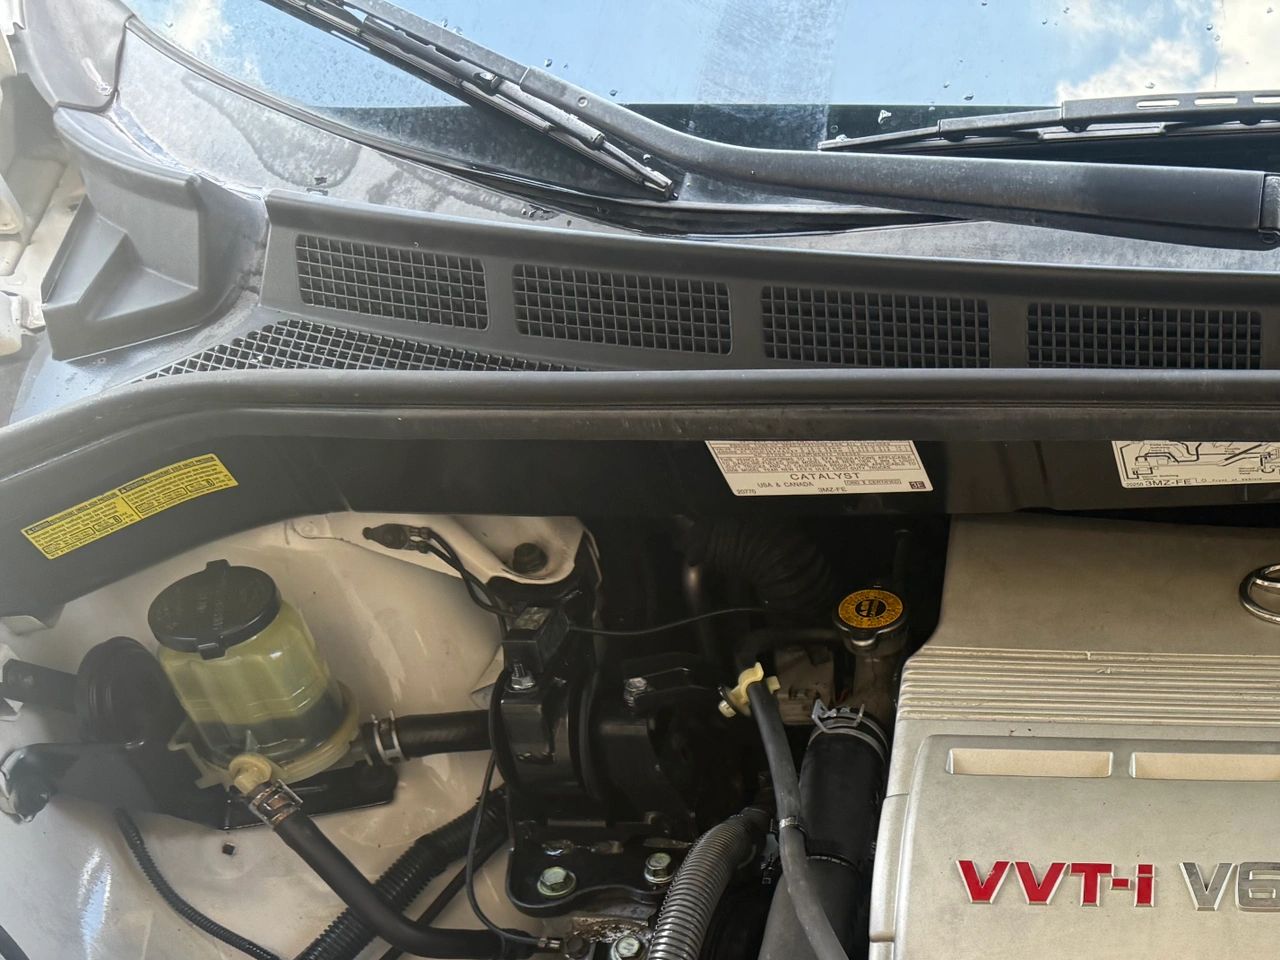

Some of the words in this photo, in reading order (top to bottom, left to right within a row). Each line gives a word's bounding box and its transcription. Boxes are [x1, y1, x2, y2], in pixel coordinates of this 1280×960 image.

[790, 473, 860, 481] CATALYST
[1145, 479, 1193, 487] 3MZ-FE
[955, 858, 1156, 909] VVT-i
